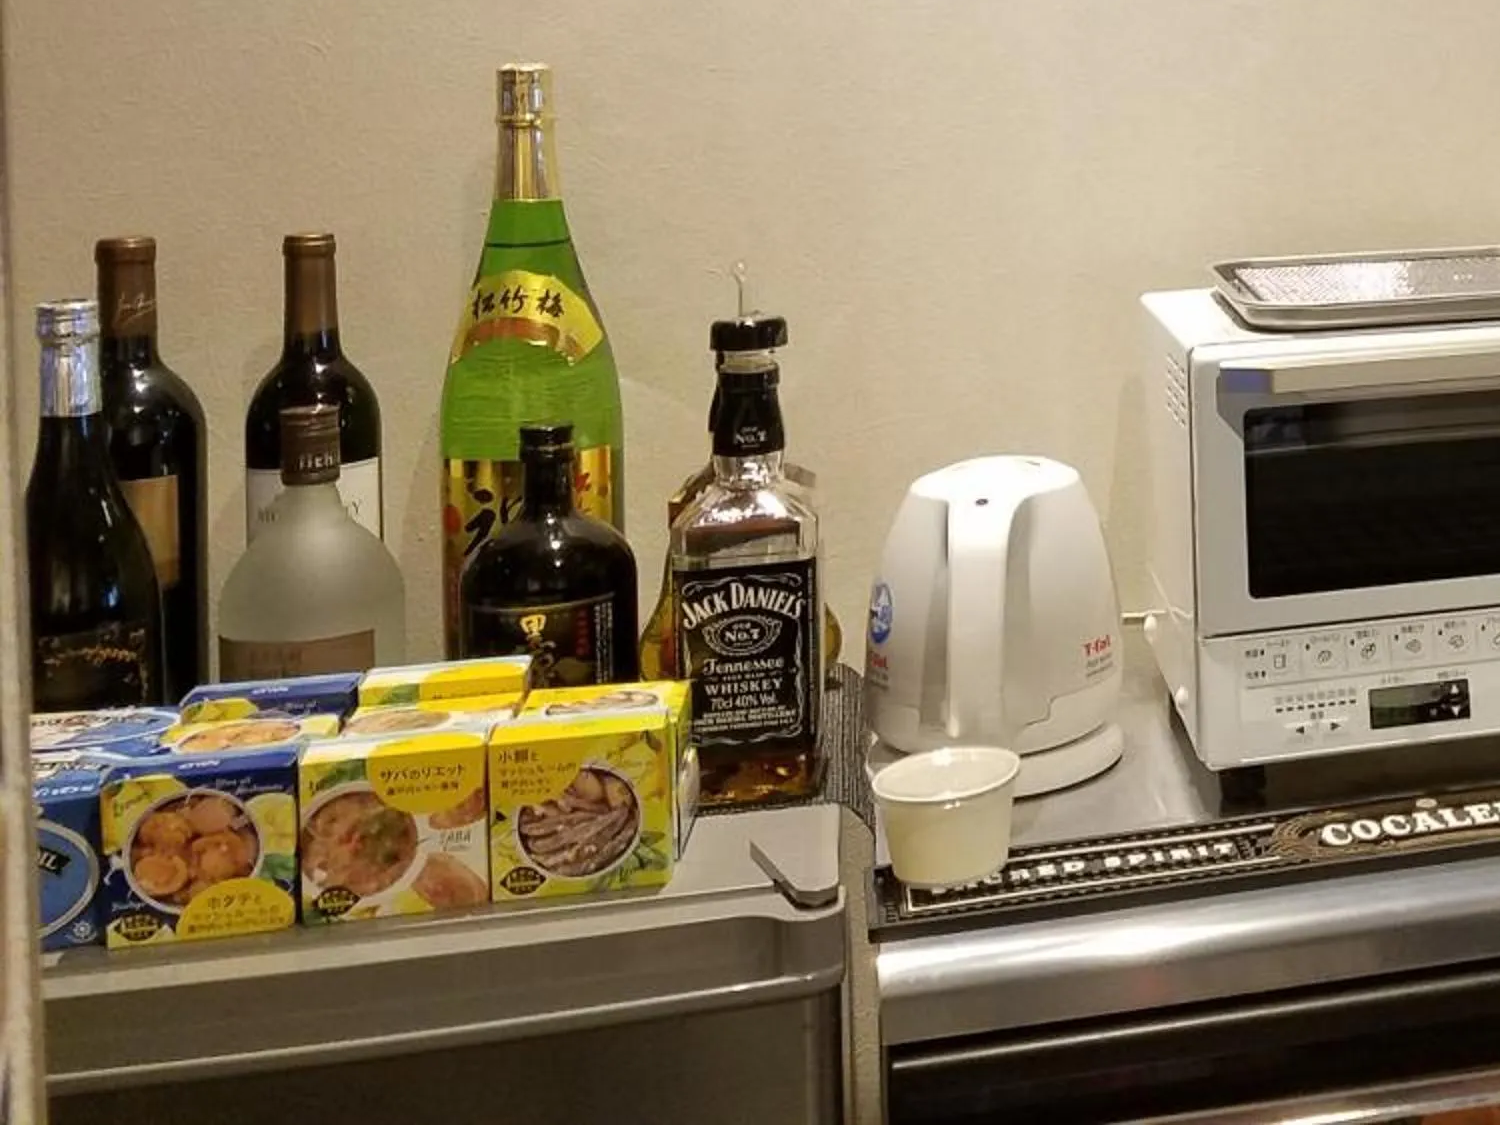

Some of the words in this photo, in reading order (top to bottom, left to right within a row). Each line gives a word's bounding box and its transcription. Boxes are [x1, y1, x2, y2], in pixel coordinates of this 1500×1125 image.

[471, 283, 565, 320] 松竹梅
[681, 590, 731, 630] JACK
[729, 582, 807, 621] DANIEL'S
[723, 627, 762, 643] No.7
[1082, 634, 1112, 657] T-fal
[701, 656, 785, 676] Tennessee
[704, 677, 784, 696] WHISKEY
[1103, 842, 1236, 869] SPIRIT
